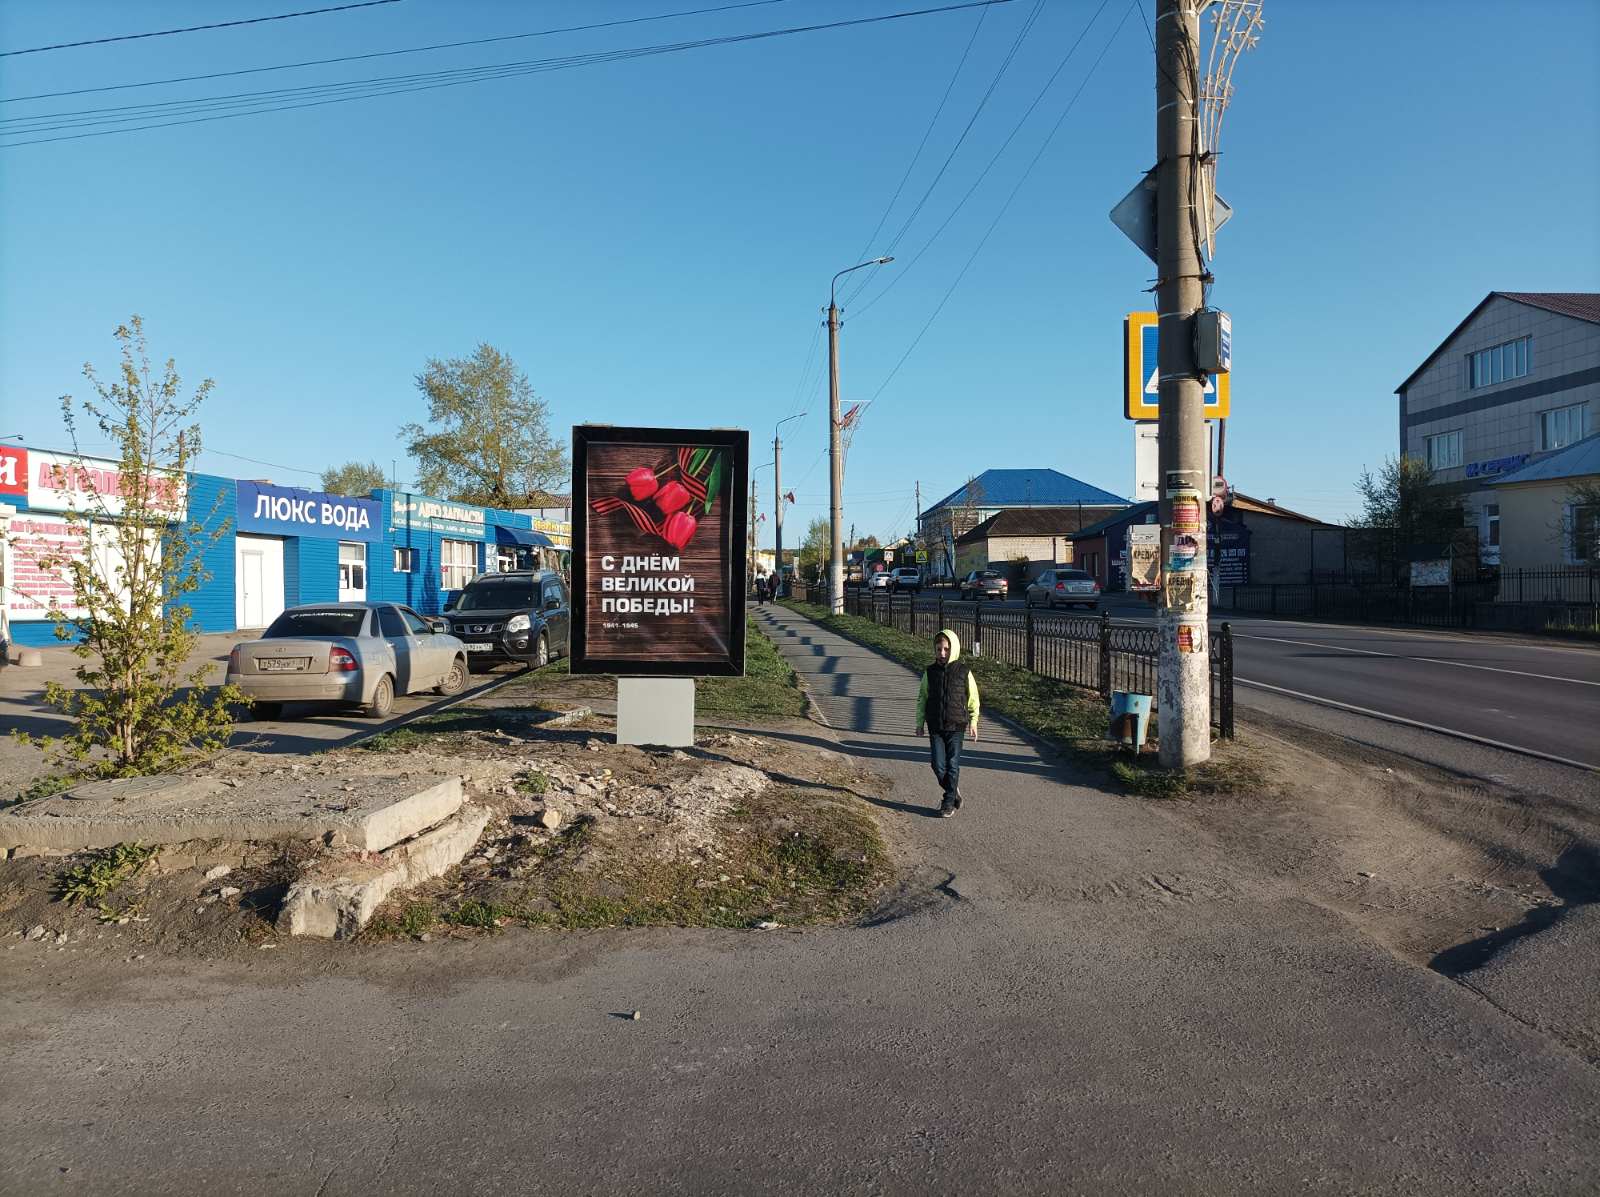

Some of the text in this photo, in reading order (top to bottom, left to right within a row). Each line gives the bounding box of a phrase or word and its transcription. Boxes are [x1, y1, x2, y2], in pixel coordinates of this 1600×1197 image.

[254, 494, 317, 524] ЛЮКС
[321, 503, 370, 531] ВОДА
[601, 553, 680, 573] С ДНЁМ
[601, 574, 695, 592] ВЕЛИКОЙ
[601, 598, 694, 616] ПОБЕДЫ!
